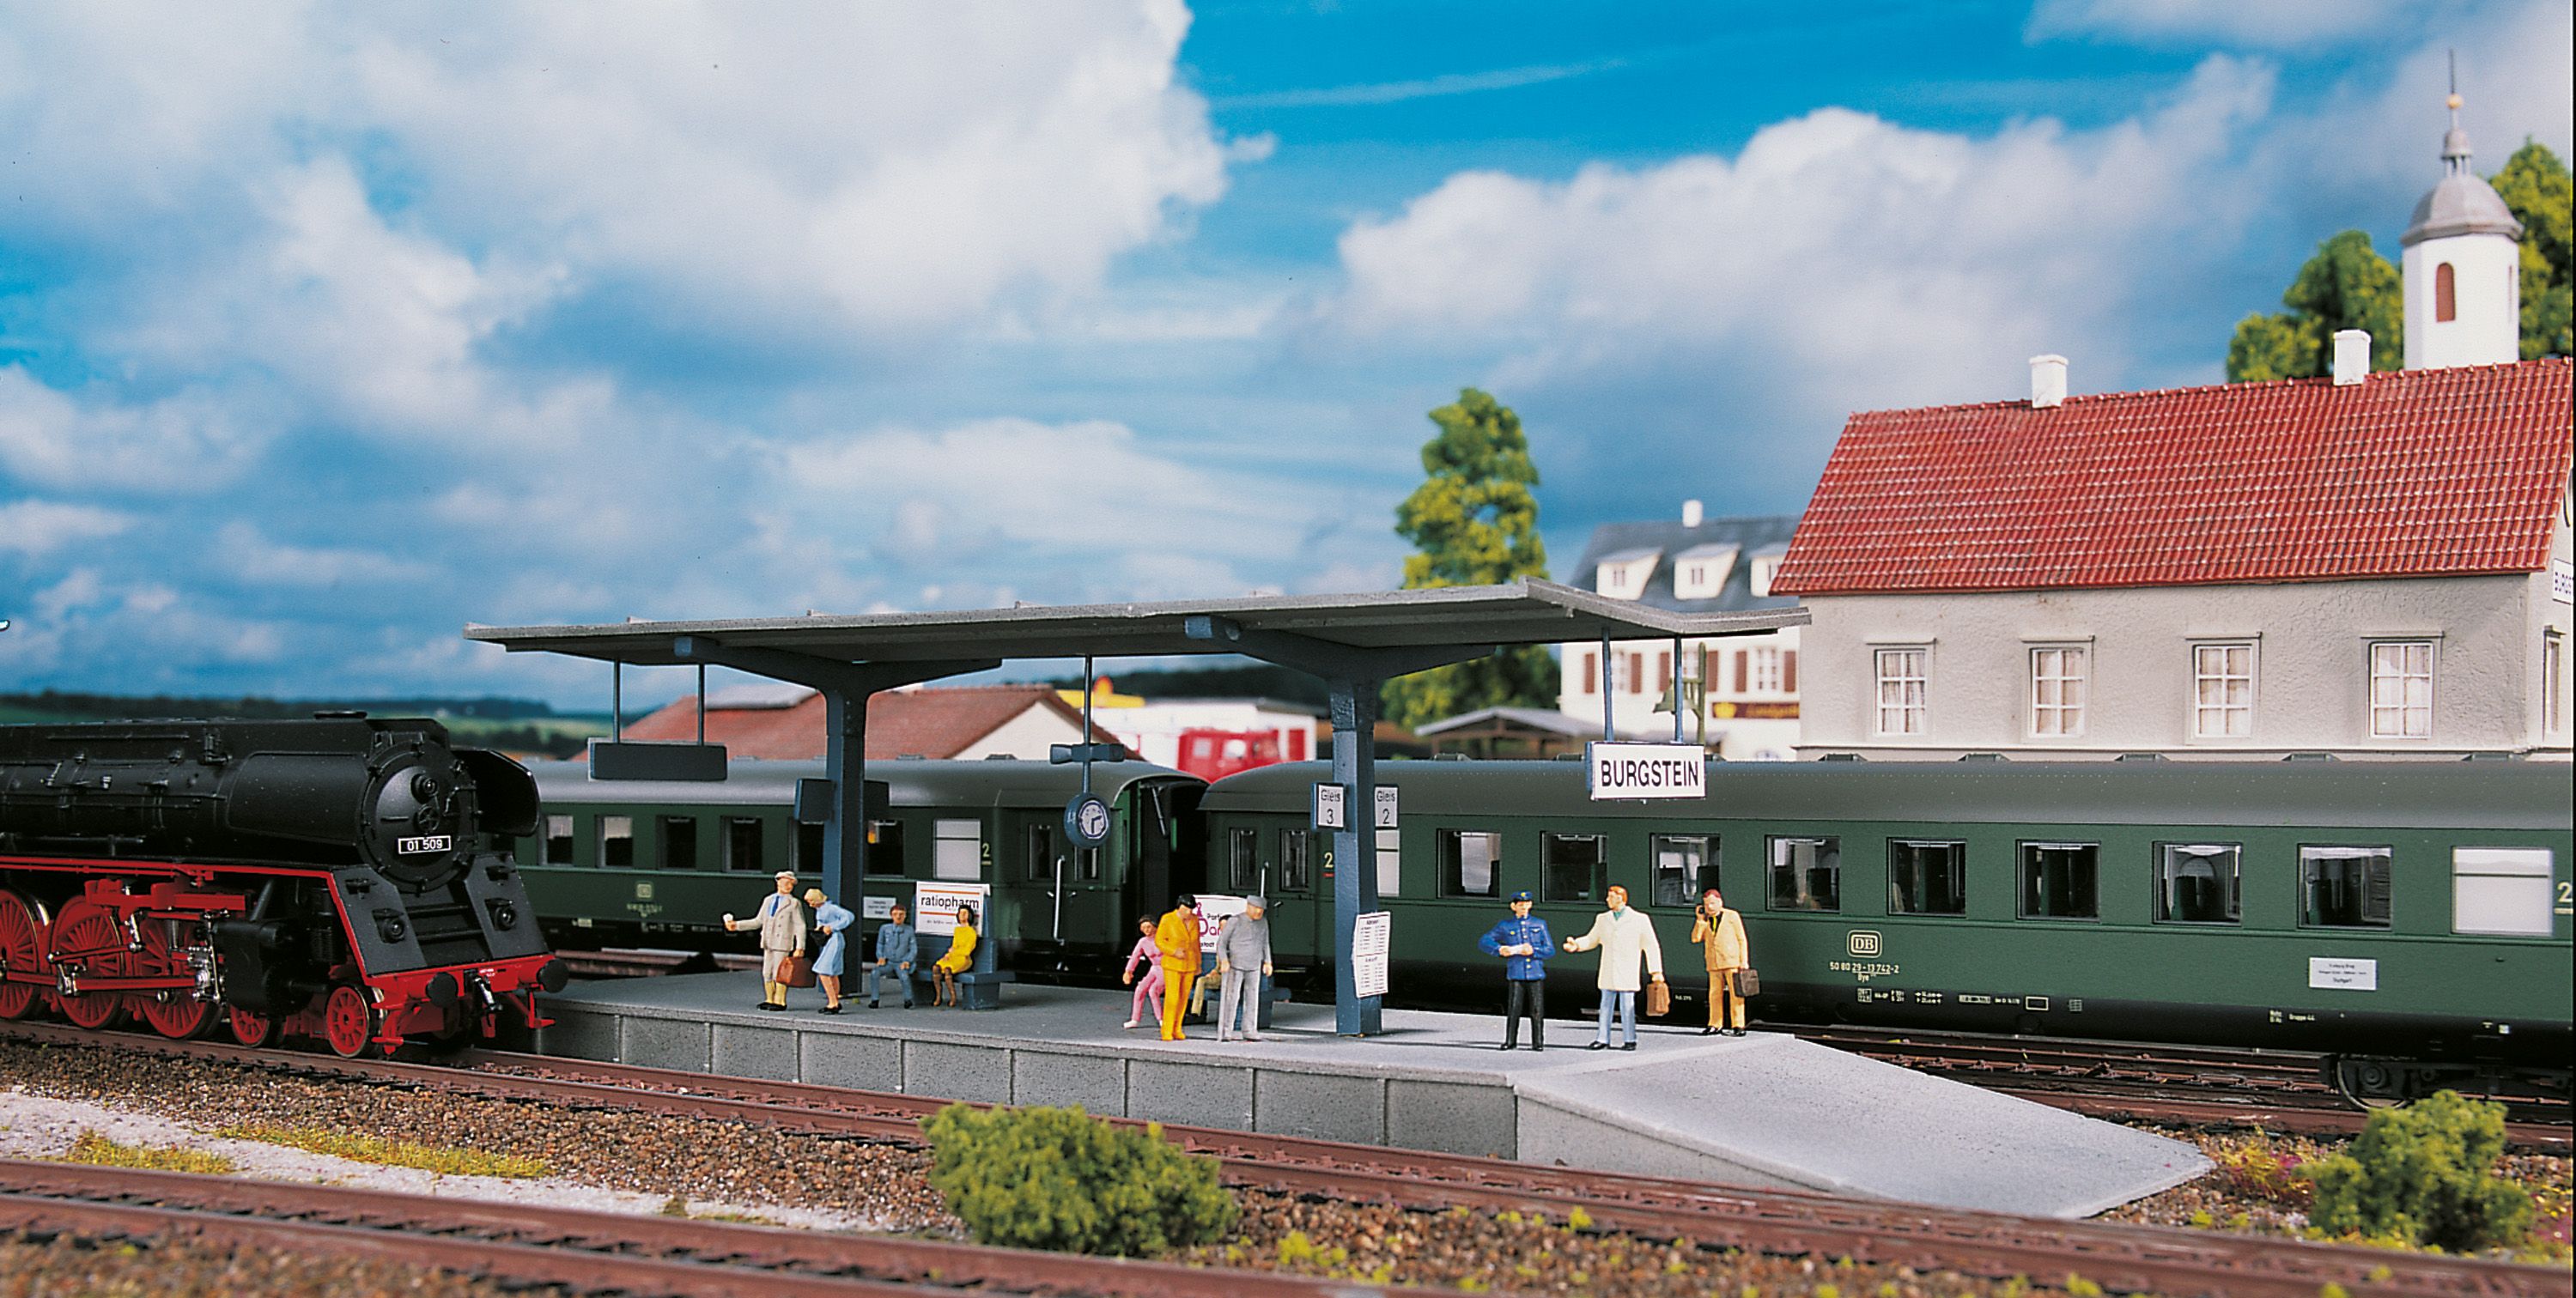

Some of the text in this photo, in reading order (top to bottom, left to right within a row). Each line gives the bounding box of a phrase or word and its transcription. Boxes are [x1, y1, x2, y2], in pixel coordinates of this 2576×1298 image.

[1601, 760, 1698, 787] BURGSTEIN
[1321, 789, 1341, 802] Gleis
[1376, 790, 1395, 802] Gleis
[1327, 808, 1334, 824] 3
[1382, 808, 1390, 824] 2
[407, 839, 443, 851] 01 509
[981, 842, 990, 858] 2
[1324, 852, 1334, 868] 2
[2557, 881, 2573, 902] 2
[920, 895, 979, 911] ratiopharm
[1855, 937, 1874, 949] DB
